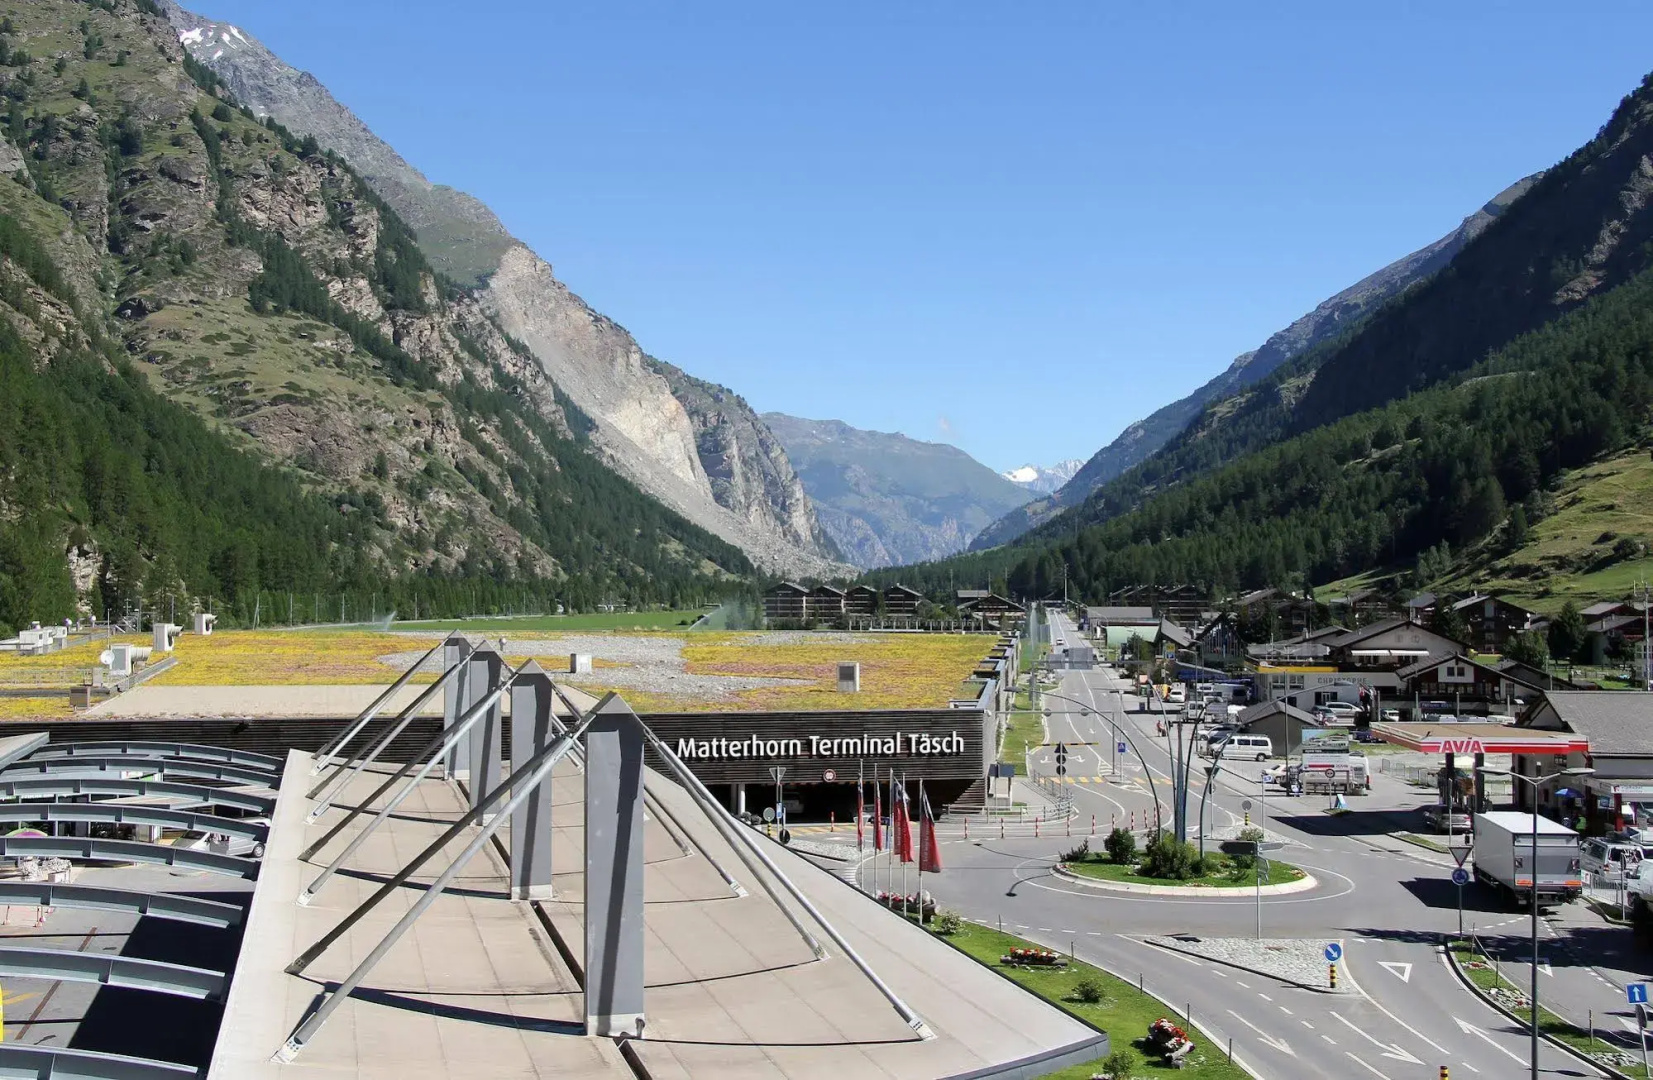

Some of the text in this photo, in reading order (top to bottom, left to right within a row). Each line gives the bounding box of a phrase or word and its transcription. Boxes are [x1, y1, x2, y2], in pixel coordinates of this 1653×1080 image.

[677, 730, 965, 758] Matterhorn Terminal Täsch
[1440, 740, 1483, 753] AVIA
